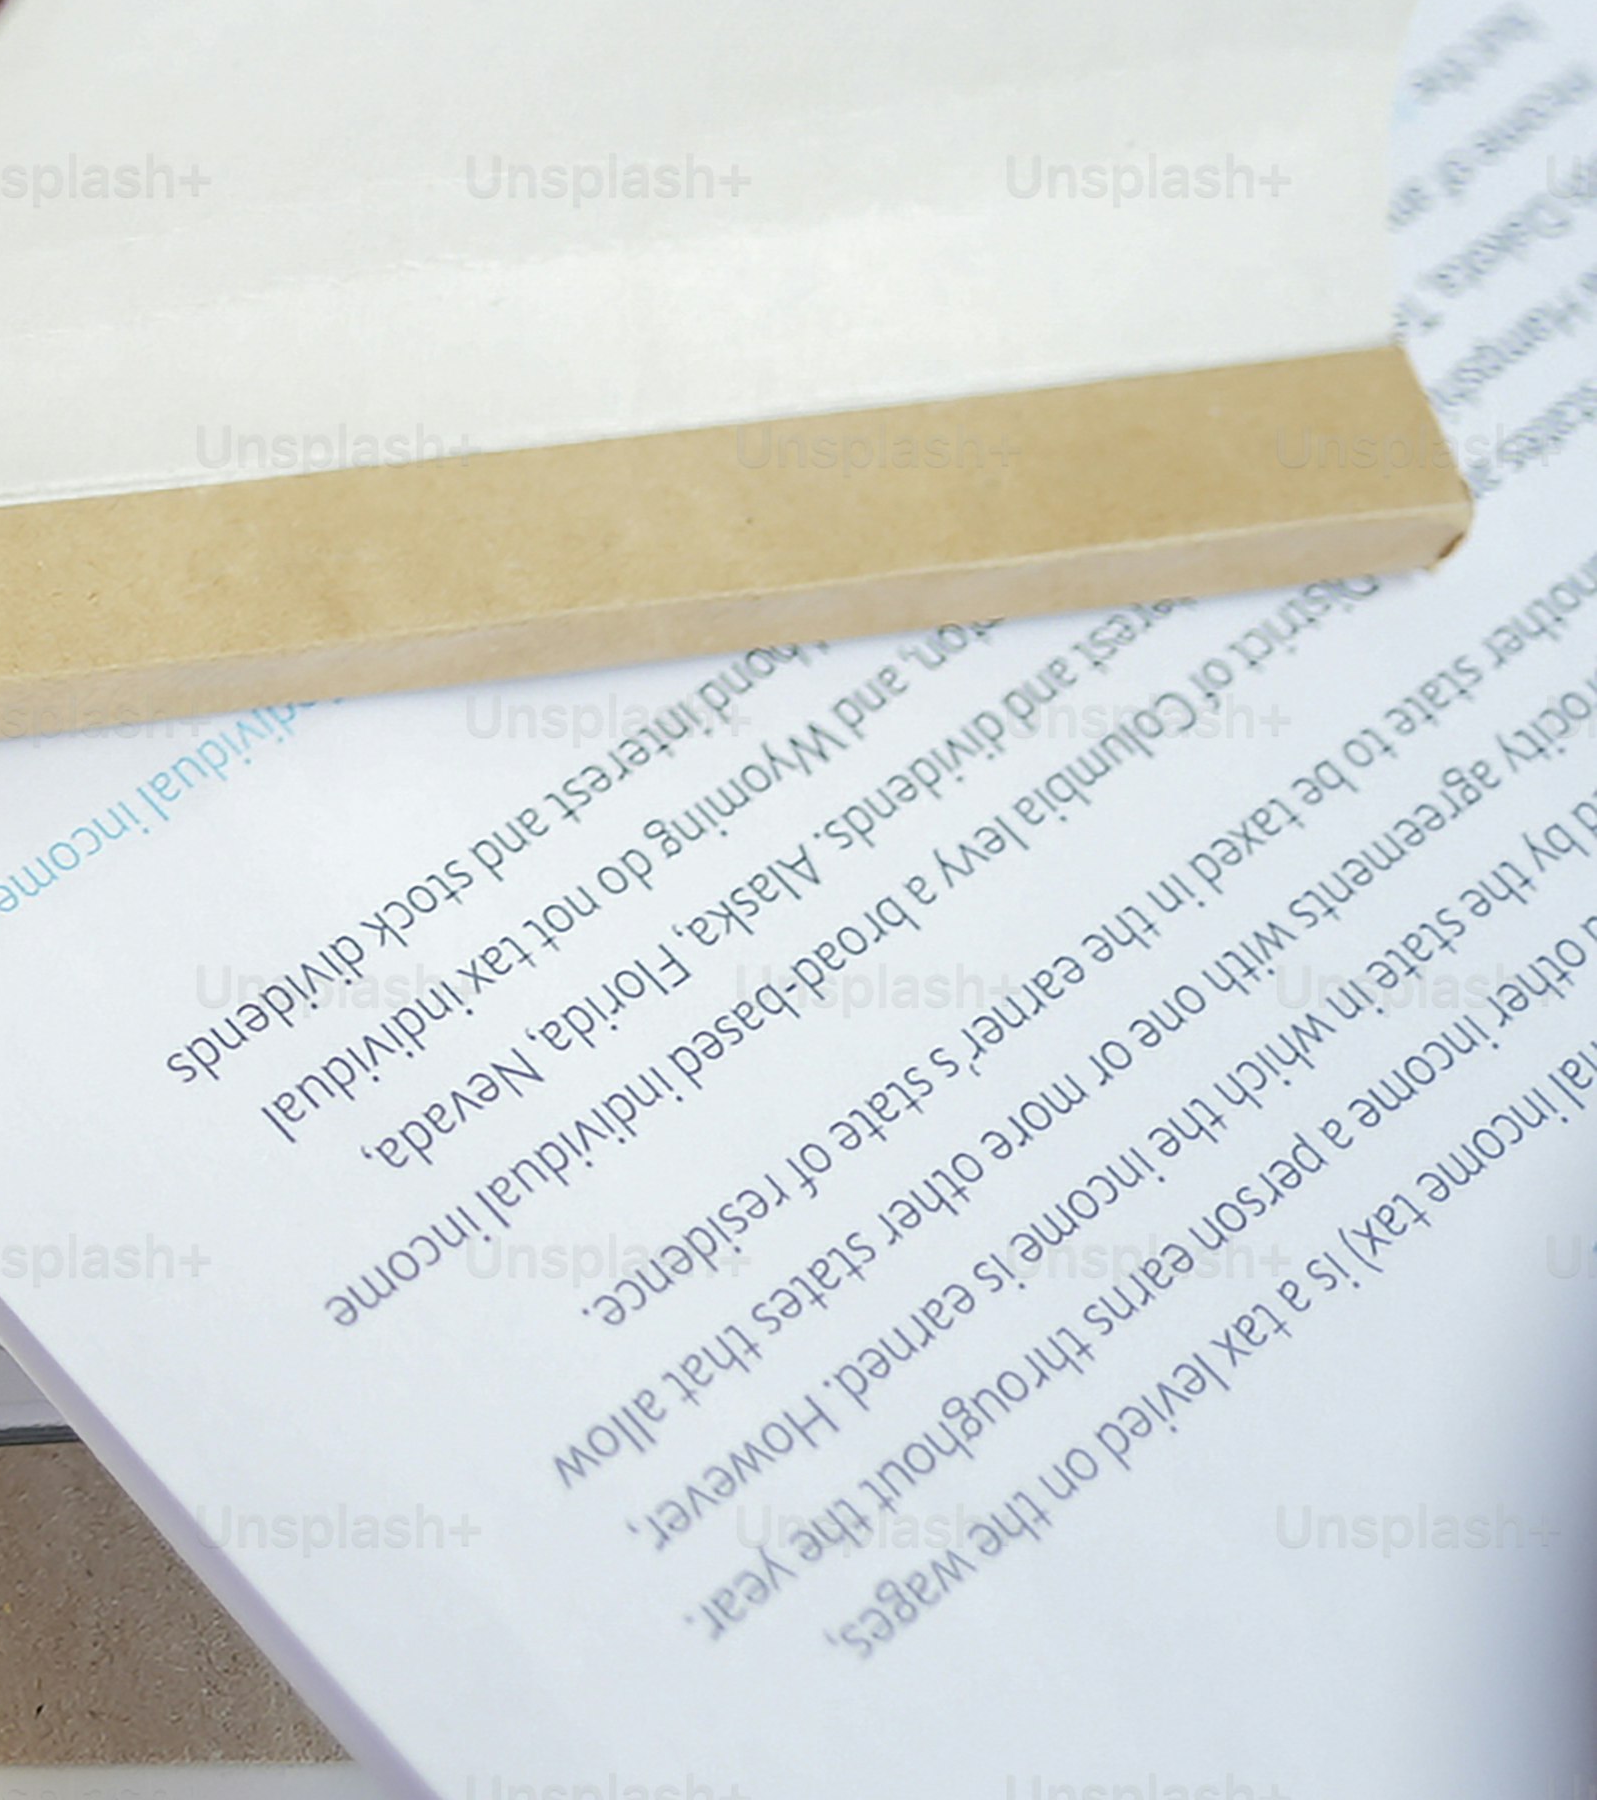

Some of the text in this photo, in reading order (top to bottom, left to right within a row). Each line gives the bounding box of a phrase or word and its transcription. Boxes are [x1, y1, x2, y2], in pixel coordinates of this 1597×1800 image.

[999, 655, 1079, 733] and
[1186, 656, 1235, 714] of
[1382, 653, 1485, 737] state
[542, 699, 713, 824] interest
[811, 709, 1006, 851] dividends.
[1010, 690, 1199, 827] Columbia
[1289, 757, 1360, 807] be
[1340, 726, 1398, 769] to
[467, 805, 551, 883] and
[930, 813, 1031, 890] levy
[1186, 796, 1306, 896] taxed
[1286, 757, 1503, 930] agreements
[259, 663, 910, 1144] and Wyoming do not tax individual
[357, 858, 475, 949] stock
[670, 842, 822, 947] Alaska,
[902, 873, 939, 907] a
[1078, 903, 1162, 964] the
[1144, 871, 1207, 914] in
[523, 942, 693, 1052] Florida,
[665, 894, 922, 1091] broad-based
[1199, 919, 1297, 997] with
[1484, 936, 1588, 1028] other
[165, 933, 365, 1084] dividends
[1126, 982, 1207, 1049] one
[359, 1046, 546, 1170] Nevada,
[826, 1064, 935, 1152] state
[1086, 1038, 1134, 1088] or
[1345, 1013, 1501, 1129] income
[473, 1064, 684, 1230] individual
[978, 1072, 1090, 1161] more
[1317, 1116, 1355, 1151] a
[1414, 1085, 1570, 1204] income
[625, 821, 1592, 1552] by the state in which the income is earned. However,
[784, 1141, 833, 1200] of
[876, 1150, 985, 1247] other
[1186, 1130, 1329, 1252] person
[323, 1204, 493, 1327] income
[580, 1171, 791, 1327] residence.
[1304, 1250, 1362, 1292] is
[1336, 1192, 1432, 1274] tax)
[749, 1229, 878, 1336] states
[1081, 1241, 1196, 1337] earns
[1274, 1277, 1312, 1313] a
[659, 1322, 763, 1407] that
[1207, 1301, 1293, 1368] tax
[551, 1387, 668, 1490] allow
[857, 1325, 1096, 1514] throughout
[1092, 1350, 1232, 1472] levied
[1036, 1445, 1100, 1501] on
[797, 1501, 875, 1563] the
[965, 1489, 1053, 1558] the
[682, 1542, 799, 1642] year.
[823, 1547, 979, 1660] wages,
